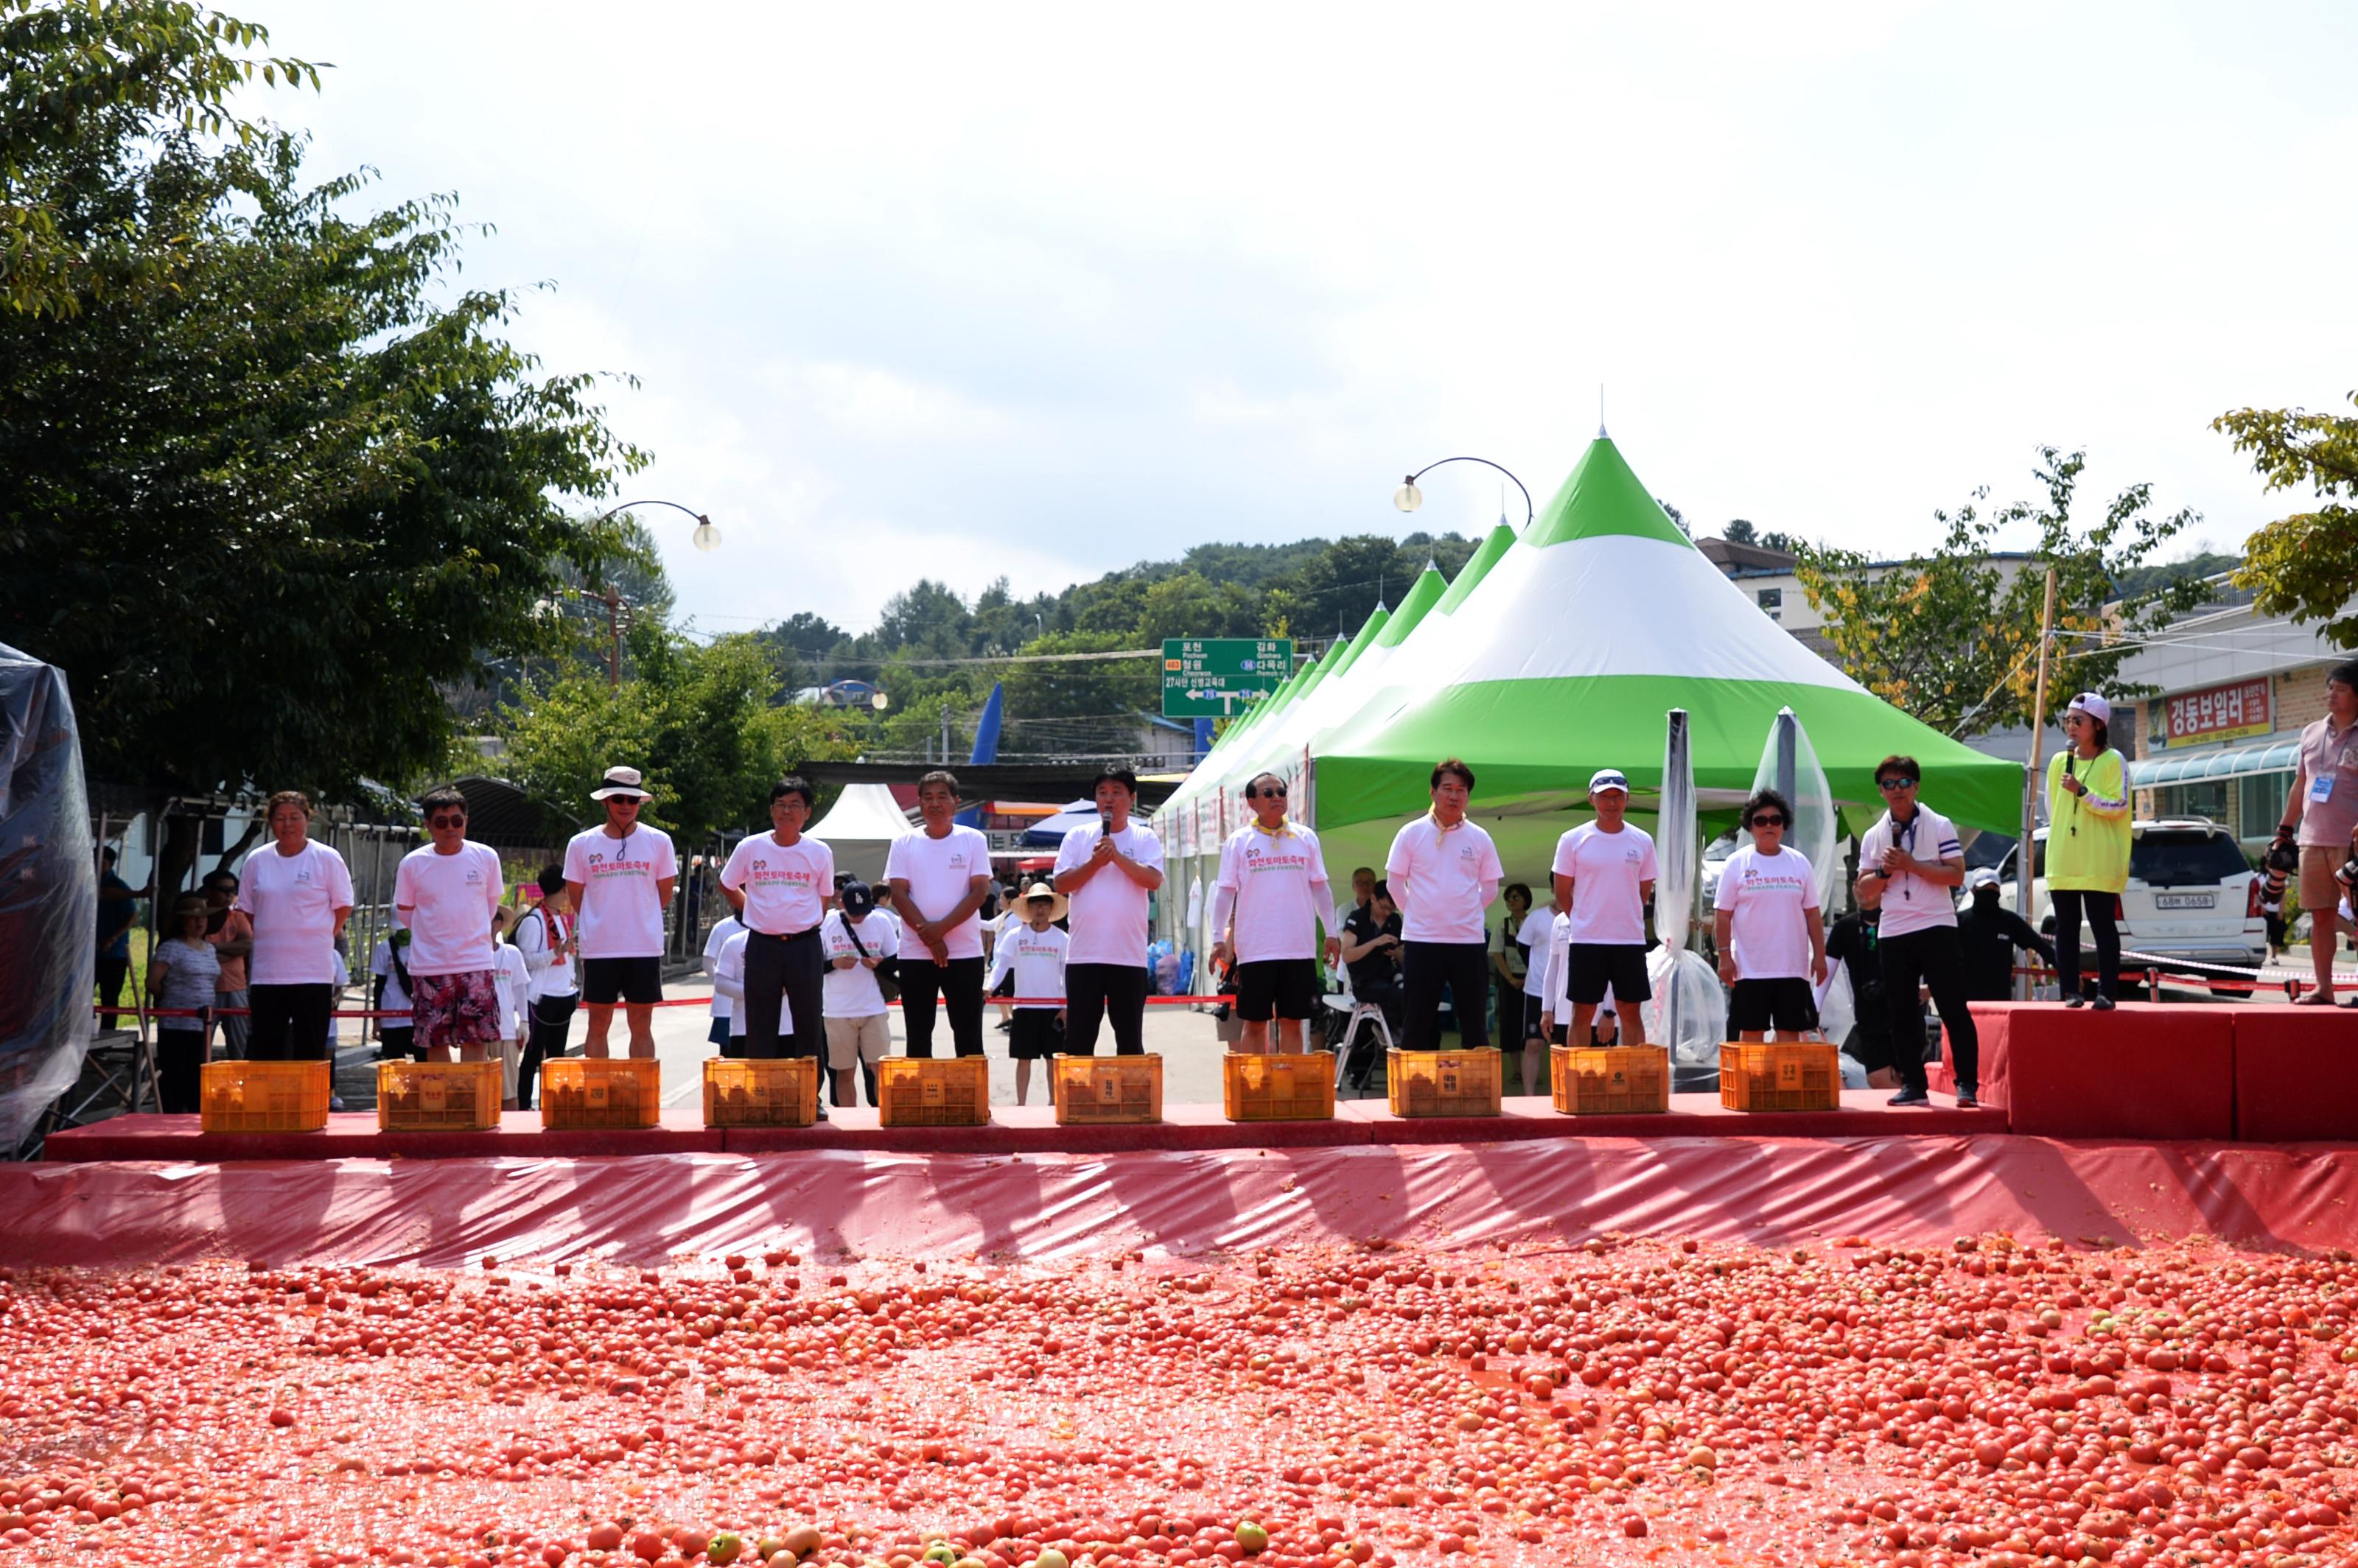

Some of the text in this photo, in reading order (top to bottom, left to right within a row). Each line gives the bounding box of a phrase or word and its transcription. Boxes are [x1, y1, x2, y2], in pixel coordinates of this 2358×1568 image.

[1182, 642, 1202, 652] 포천
[2171, 687, 2243, 735] 경동보일러
[1249, 855, 1304, 867] 화천토마토축제
[592, 861, 649, 872] 화천토마토축제
[755, 871, 810, 881] 화천토마토축제
[2185, 896, 2208, 906] 0658
